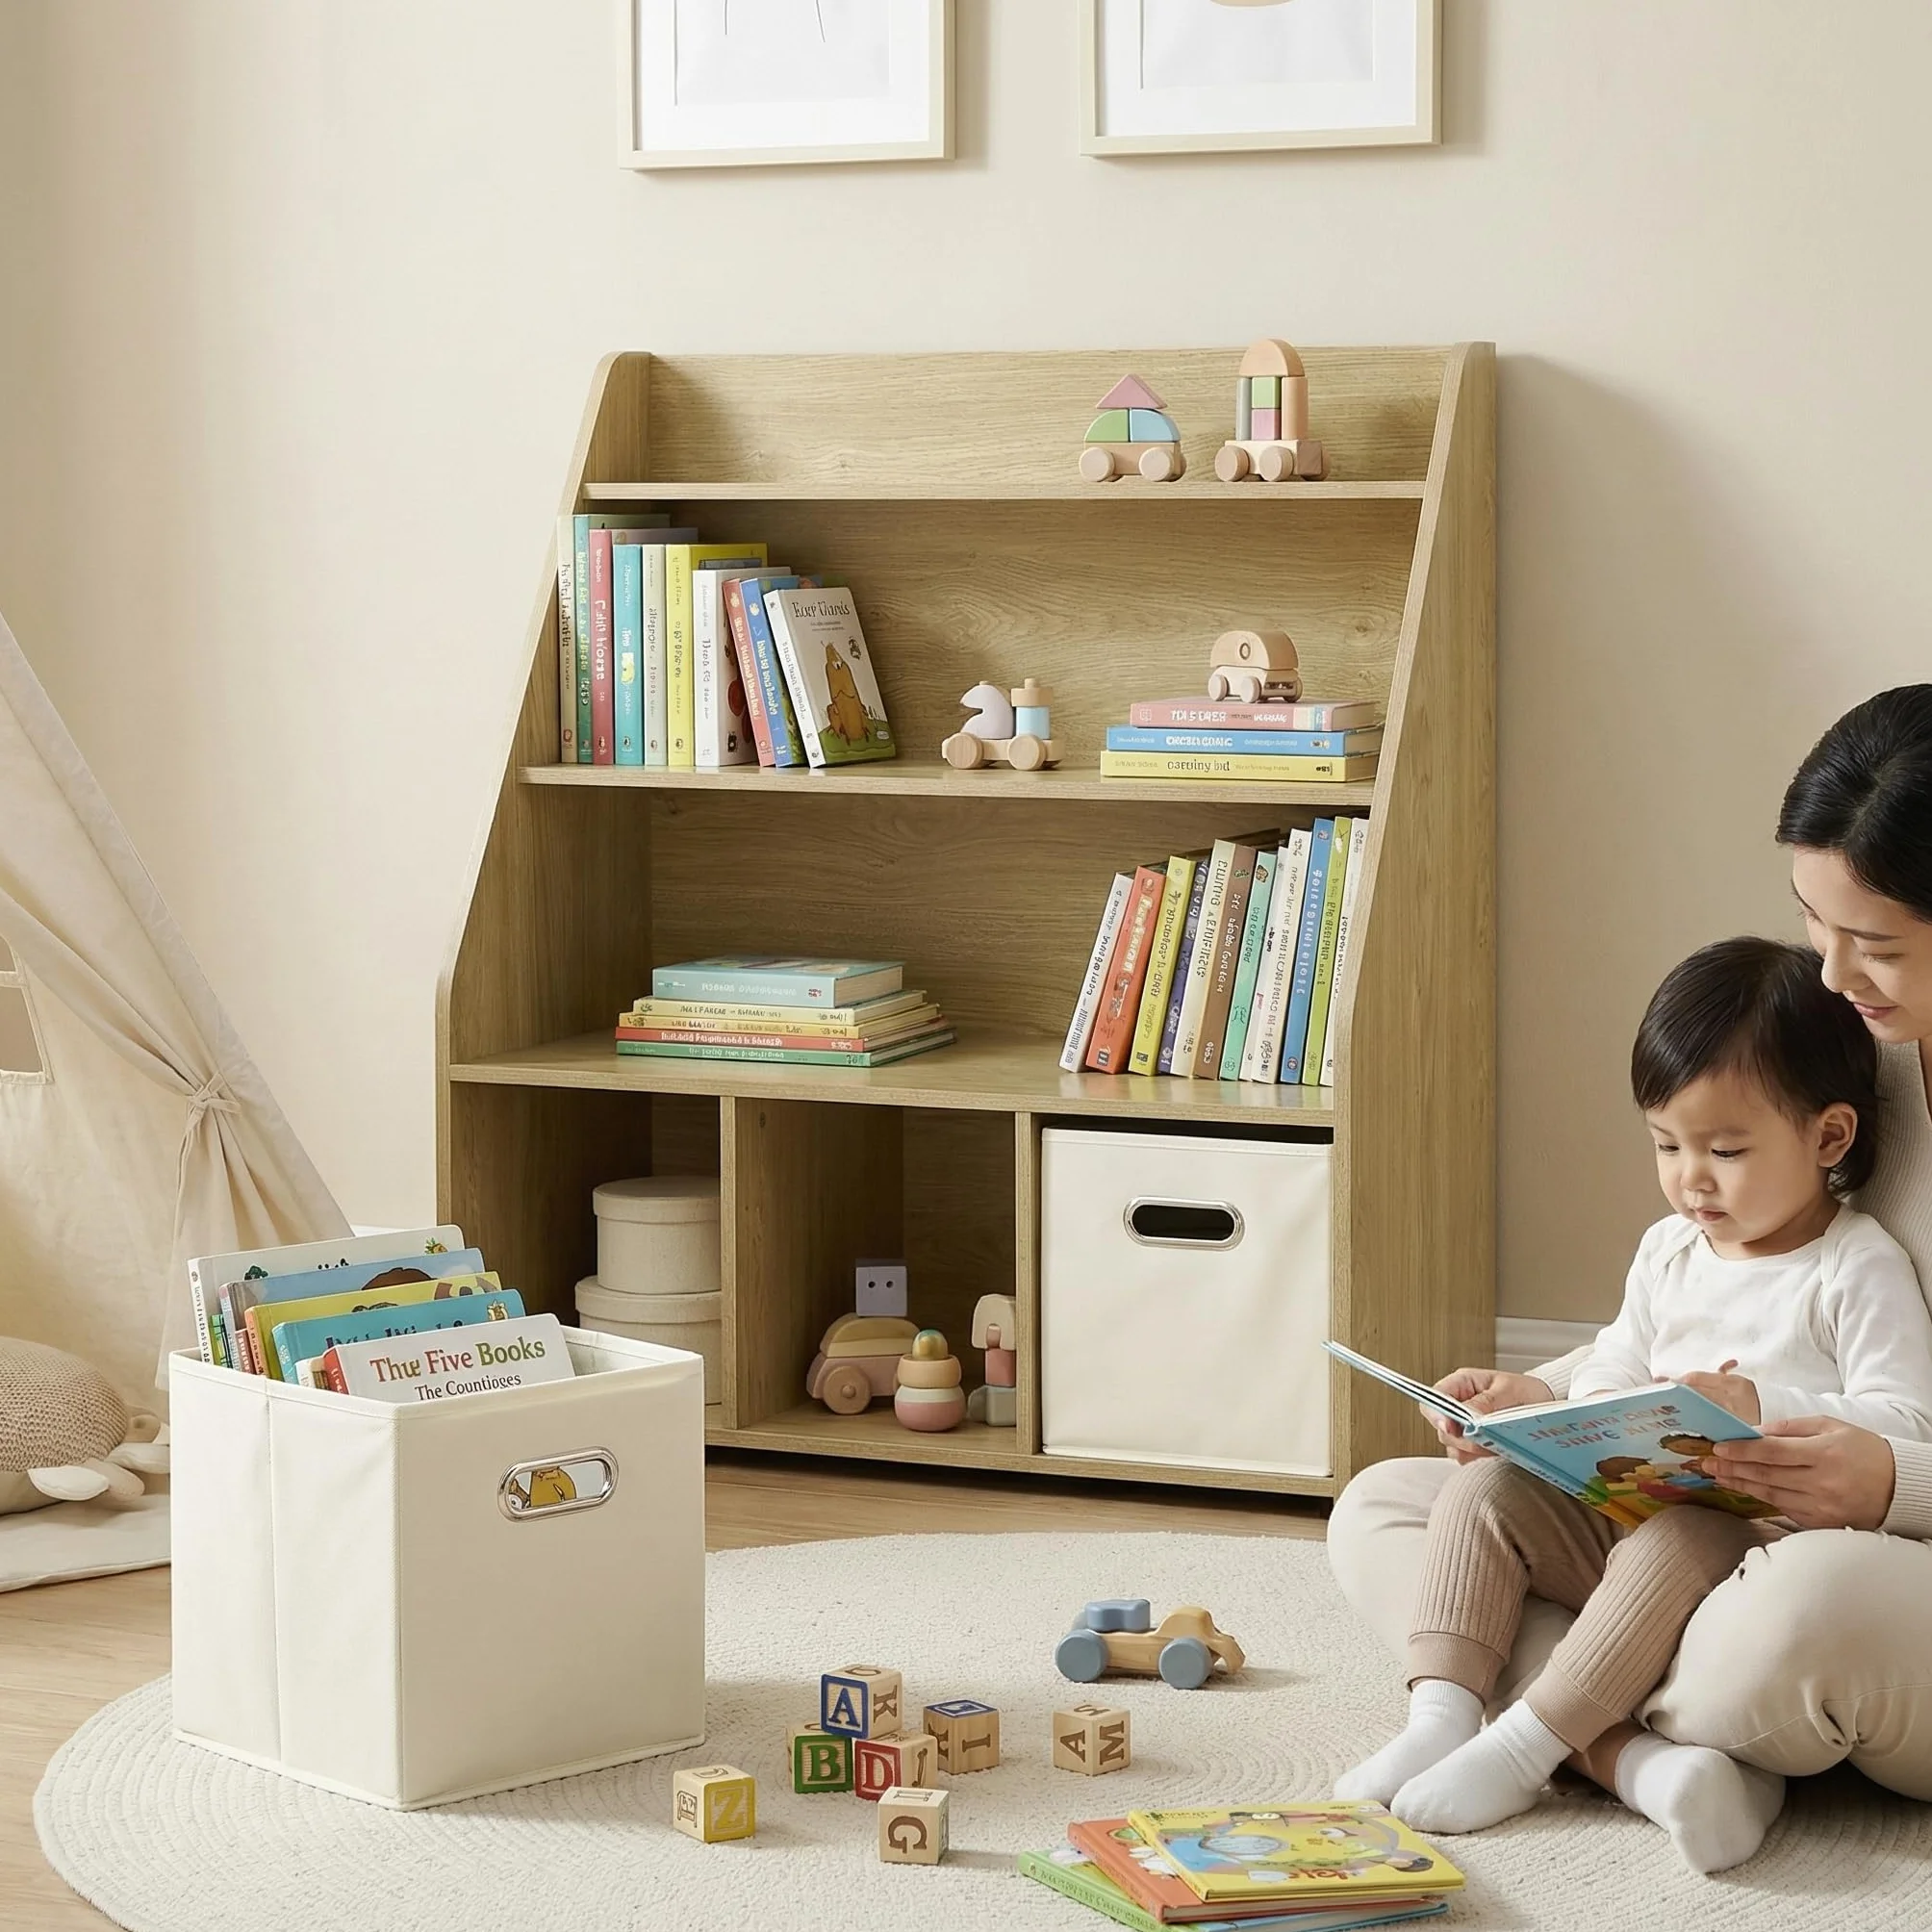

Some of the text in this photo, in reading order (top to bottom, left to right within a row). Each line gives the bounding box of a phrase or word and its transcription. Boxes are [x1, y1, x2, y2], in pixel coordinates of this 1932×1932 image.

[424, 1348, 474, 1375] Five
[475, 1335, 546, 1366] Books
[415, 1384, 443, 1401] The
[828, 1687, 861, 1728] A
[873, 1685, 898, 1724] K
[807, 1743, 841, 1782] B
[1059, 1729, 1085, 1763] A
[1099, 1720, 1125, 1766] M
[861, 1751, 894, 1791] D
[714, 1788, 744, 1829] Z
[887, 1816, 928, 1854] G
